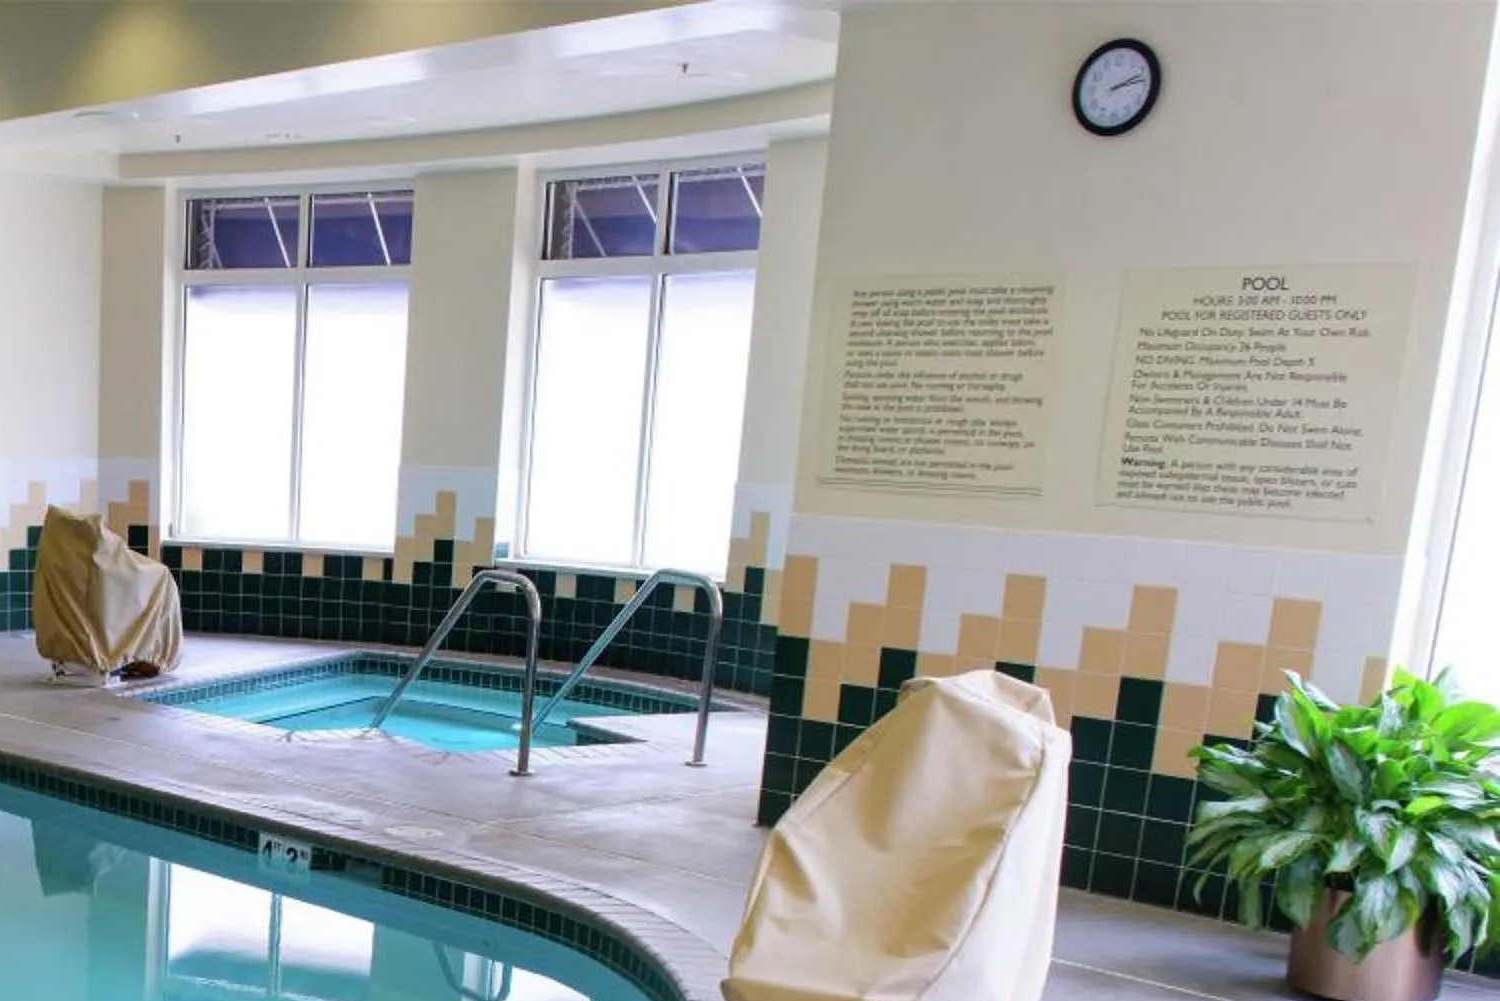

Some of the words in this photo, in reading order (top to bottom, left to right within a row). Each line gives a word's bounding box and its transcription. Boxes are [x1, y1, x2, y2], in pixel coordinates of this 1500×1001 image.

[1241, 277, 1289, 291] POOL
[1288, 311, 1332, 321] GUESTS
[1334, 310, 1368, 320] ONLY
